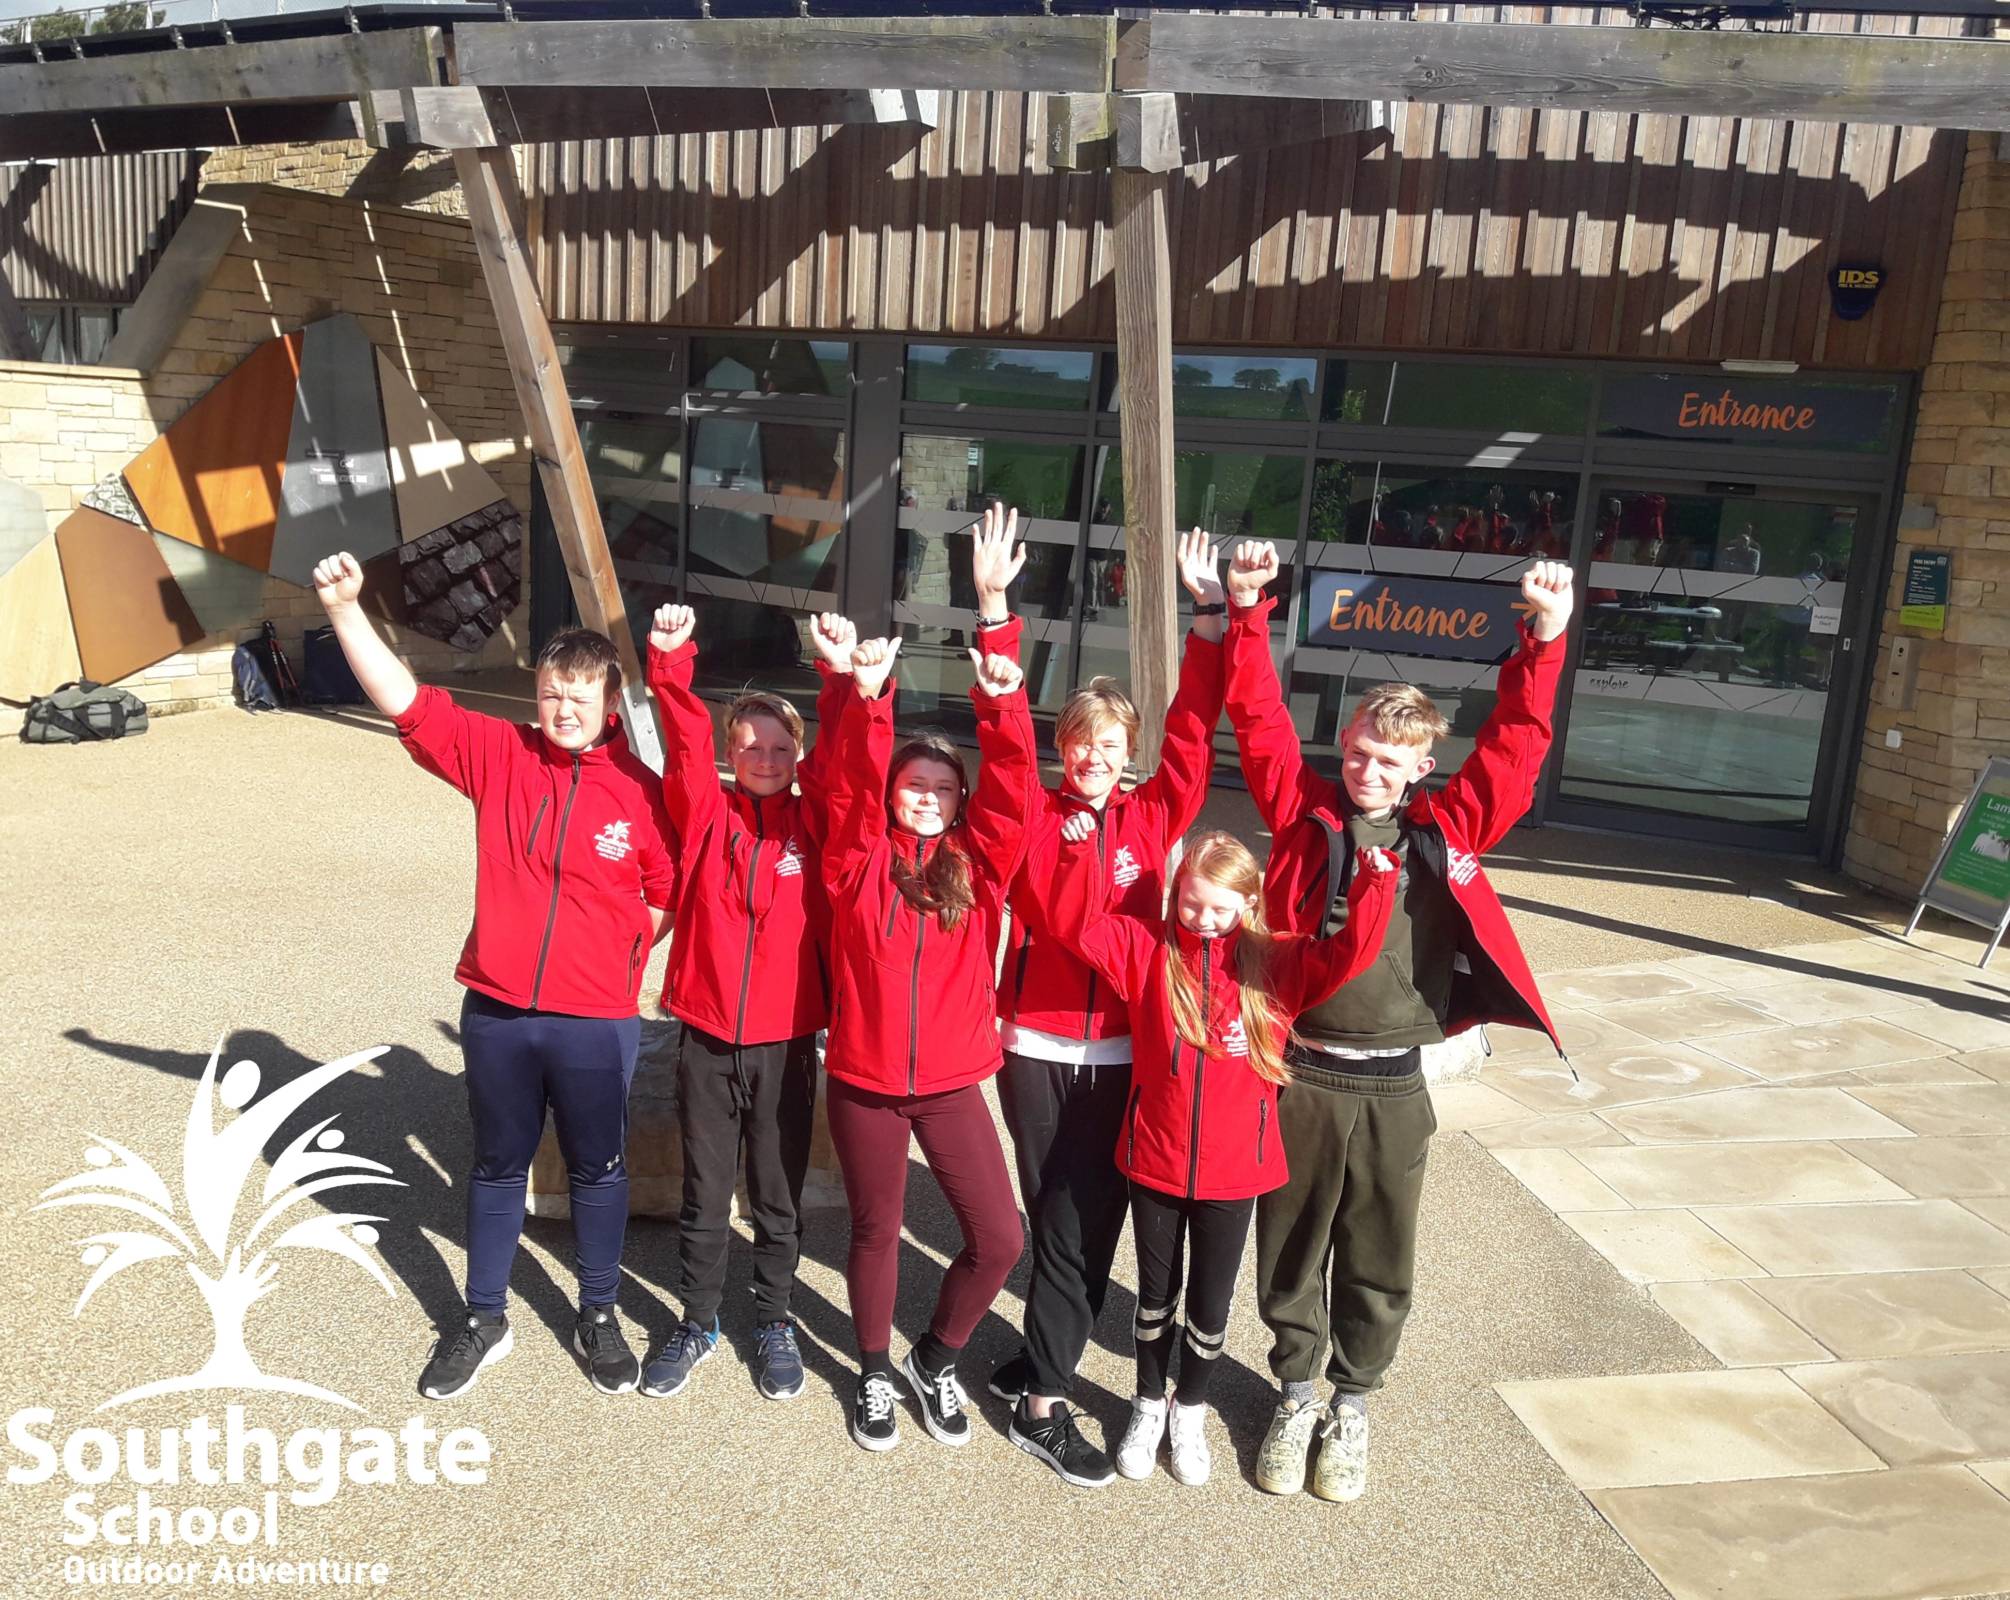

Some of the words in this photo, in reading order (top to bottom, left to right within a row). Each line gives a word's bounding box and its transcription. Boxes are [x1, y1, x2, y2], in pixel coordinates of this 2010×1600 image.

[1838, 270, 1879, 284] IDS
[1678, 389, 1816, 432] Entrance
[1328, 586, 1491, 640] Entrance
[1589, 674, 1630, 692] explore
